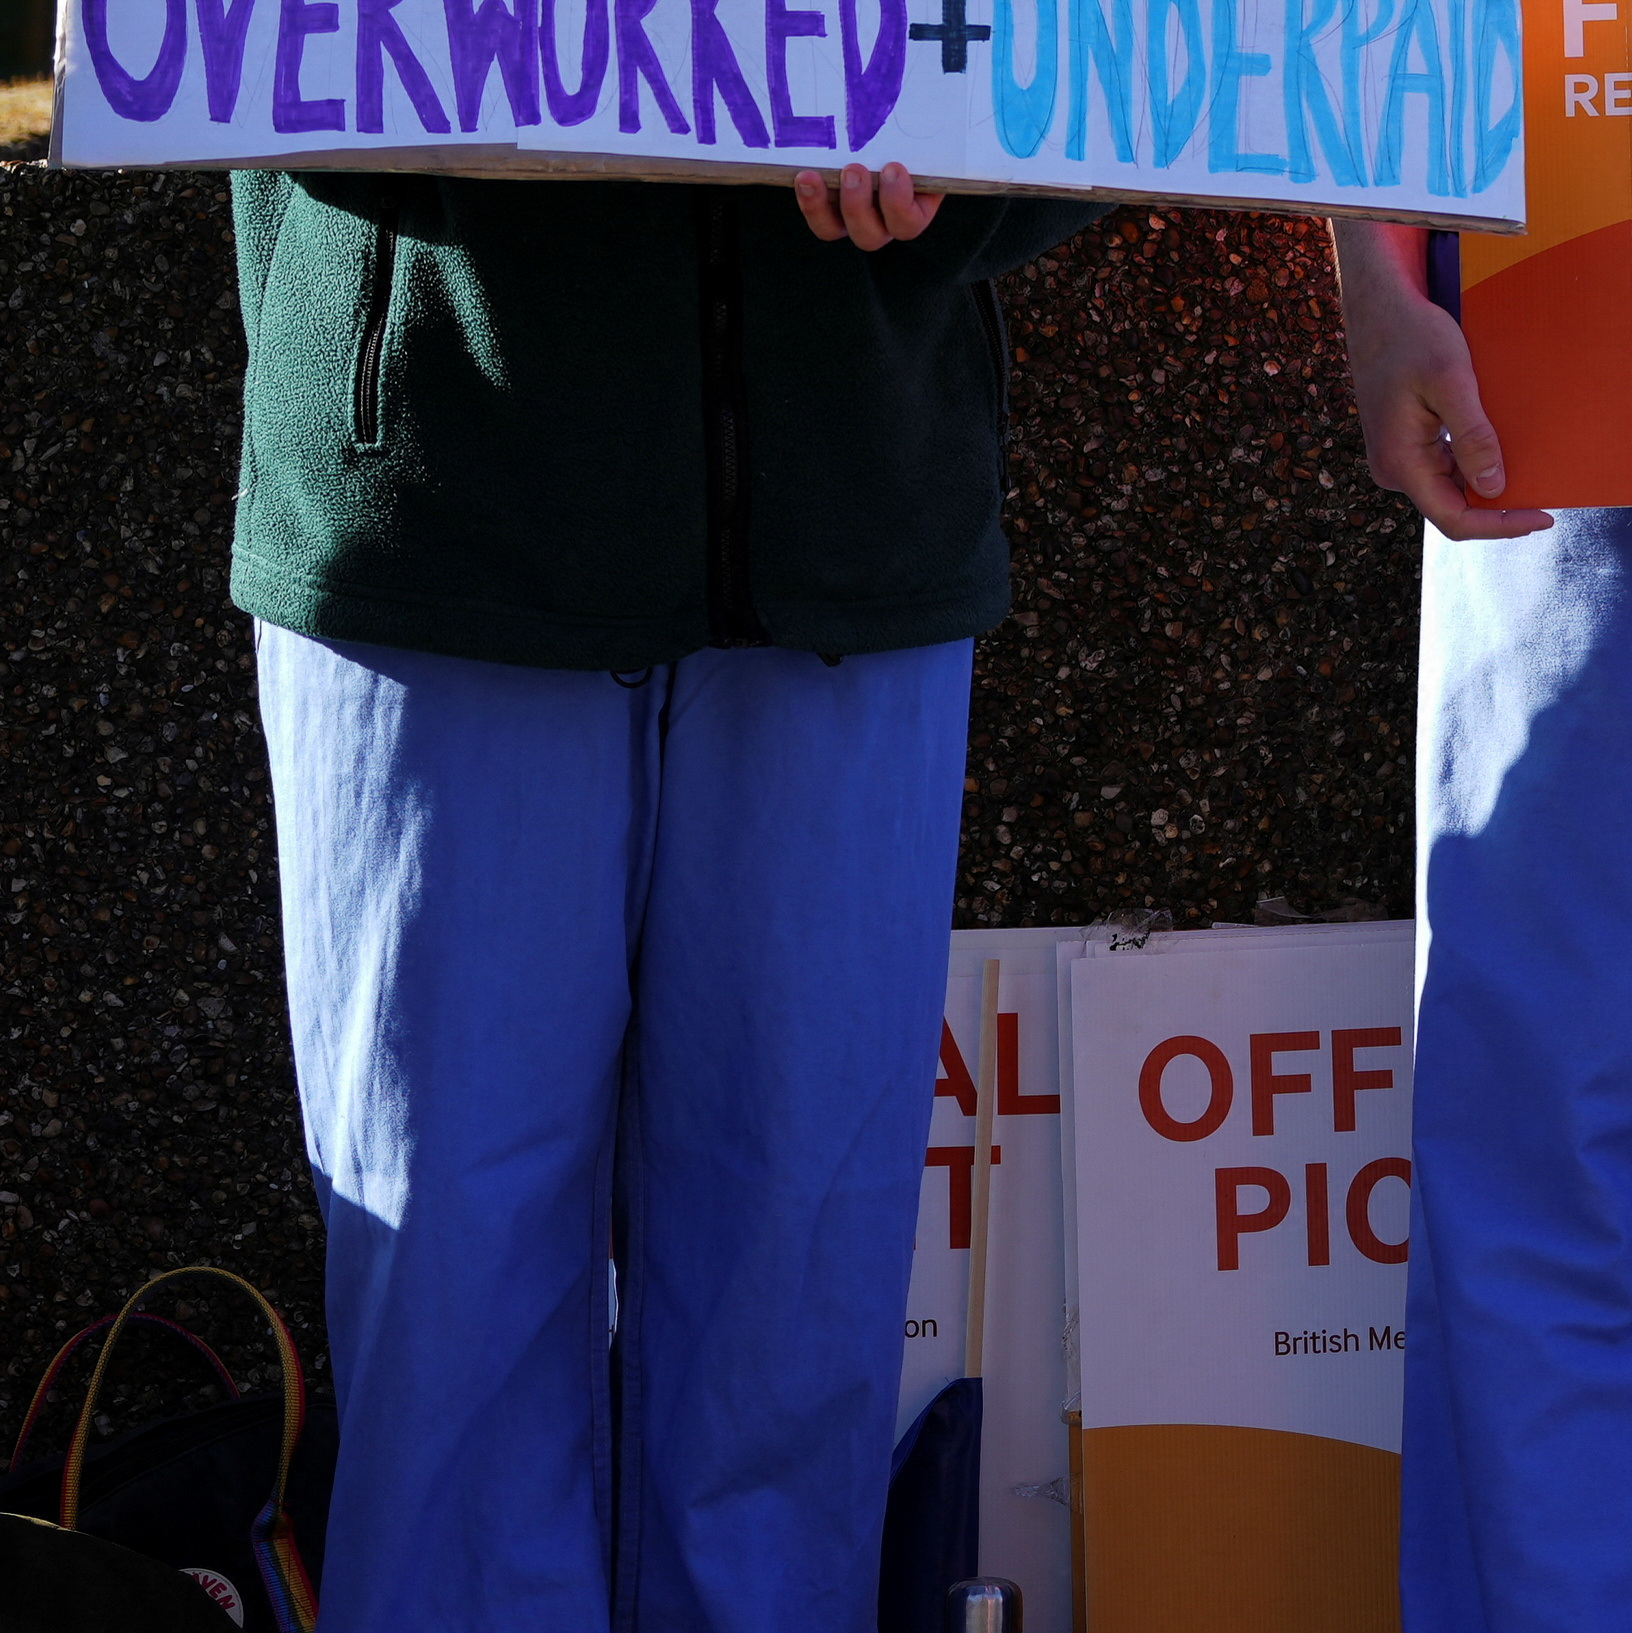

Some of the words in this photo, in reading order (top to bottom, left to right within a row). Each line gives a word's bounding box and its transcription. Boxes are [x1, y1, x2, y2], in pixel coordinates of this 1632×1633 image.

[1139, 1026, 1402, 1143] OFF
[913, 1145, 1002, 1249] T
[1274, 1328, 1360, 1356] British
